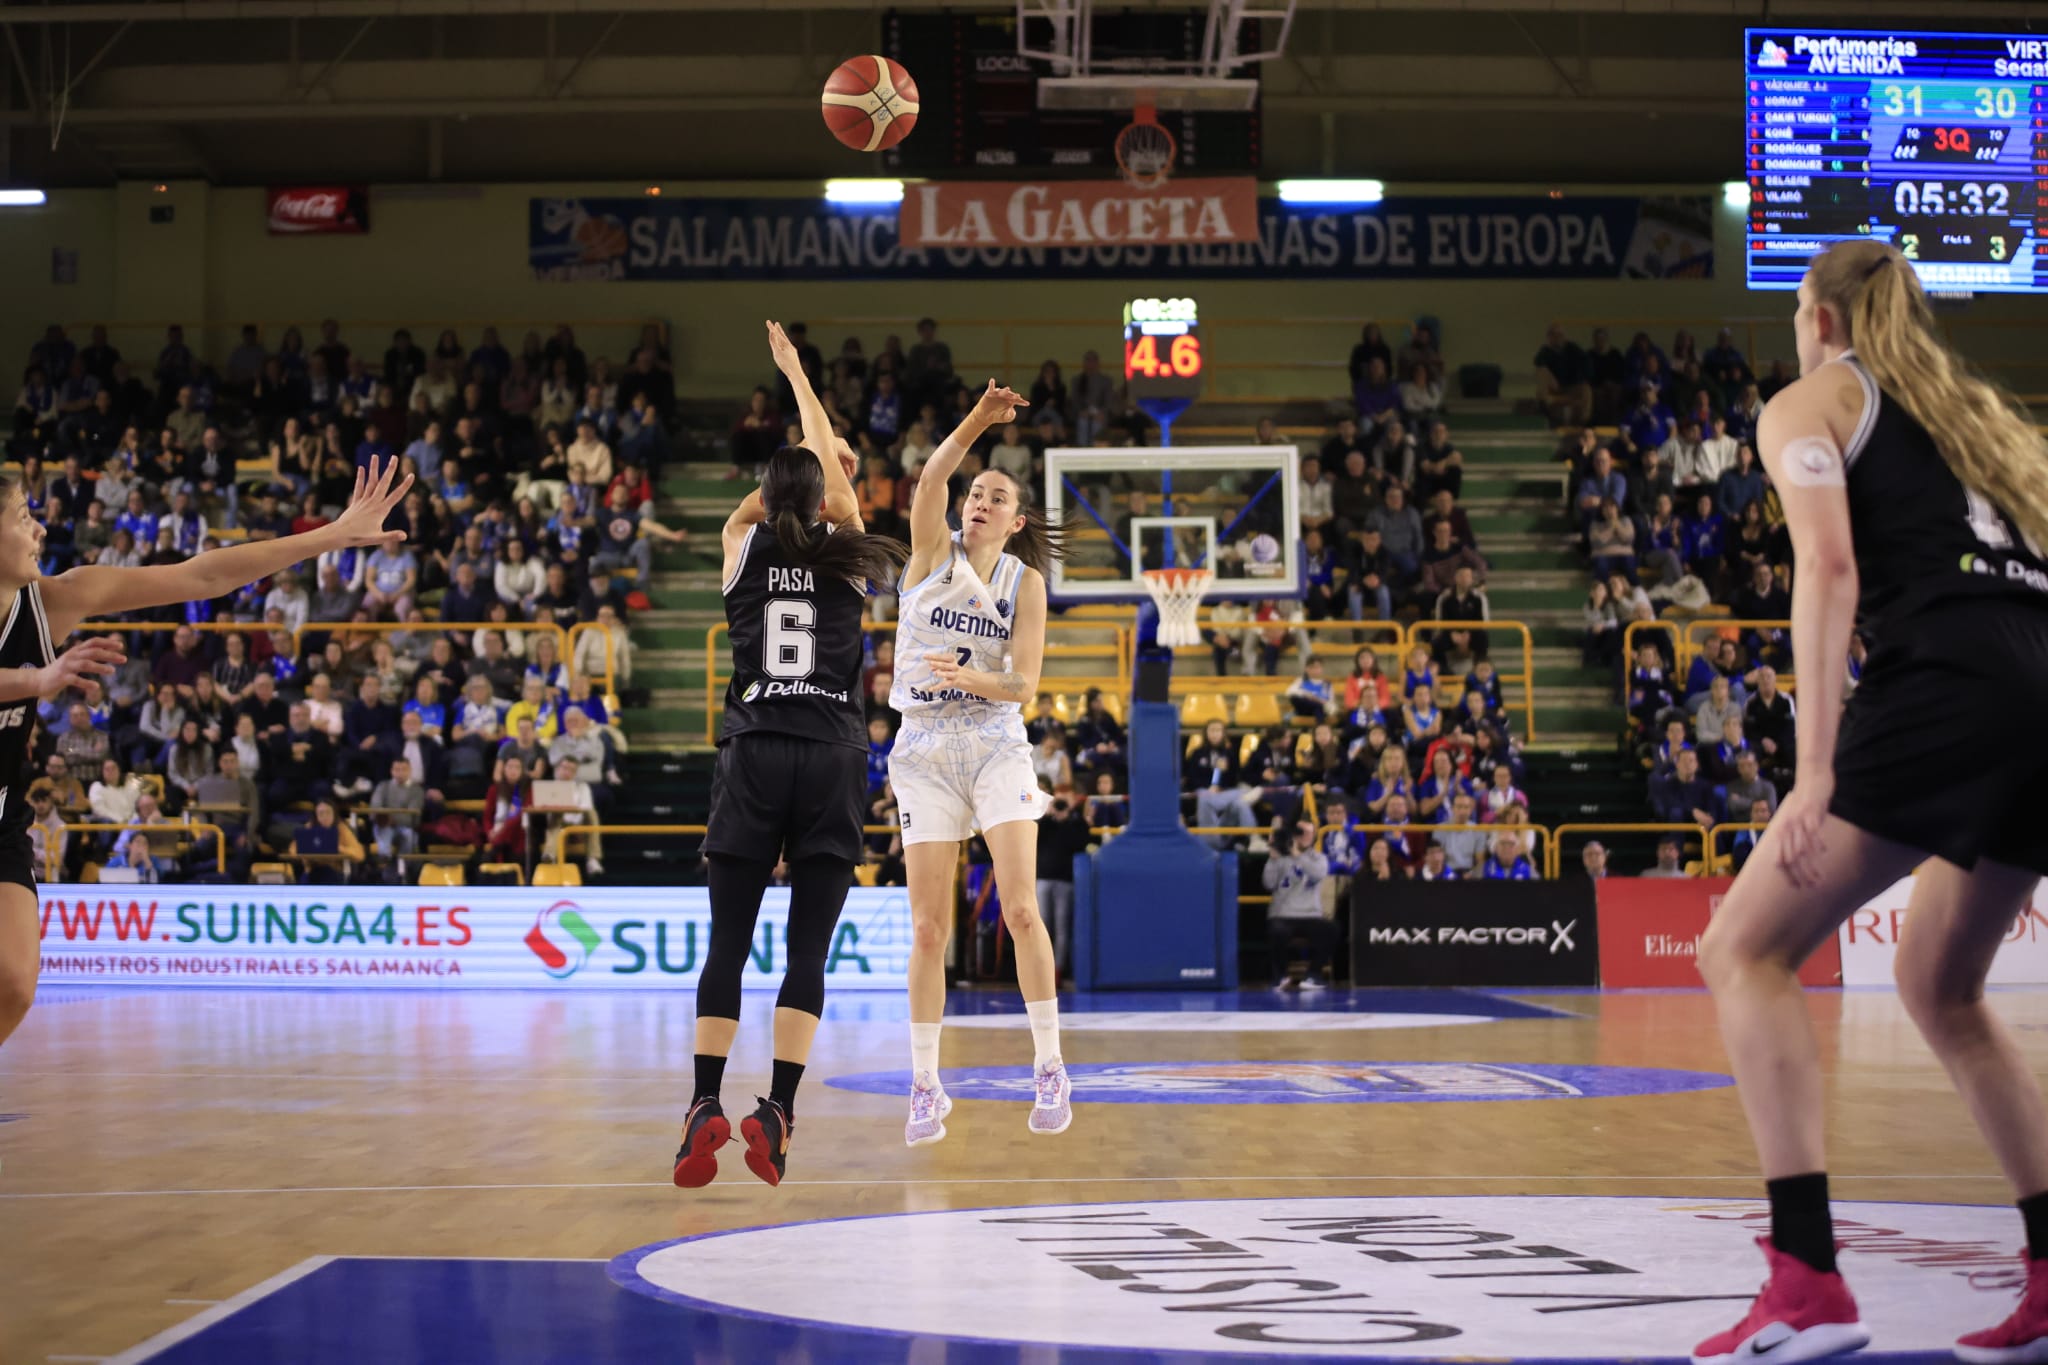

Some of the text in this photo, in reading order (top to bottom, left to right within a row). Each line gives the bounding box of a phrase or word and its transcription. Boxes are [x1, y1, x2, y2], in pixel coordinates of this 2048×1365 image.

[1794, 36, 1918, 57] Perfumerías
[975, 56, 1031, 71] LOCAL
[1808, 56, 1904, 75] AVENIDA
[1884, 85, 1923, 117] 31
[1974, 87, 2017, 119] 30
[1933, 127, 1971, 152] 3Q
[1895, 181, 2009, 217] 05:32
[1353, 214, 1414, 266] DE
[1428, 214, 1615, 267] EUROPA
[1902, 234, 1920, 260] 2
[1990, 236, 2007, 261] 3
[1130, 335, 1202, 378] 4.6
[768, 567, 815, 593] PASA
[762, 598, 816, 679] 6
[1369, 926, 1432, 945] MAX
[1437, 926, 1548, 945] FACTOR
[167, 957, 319, 976] INDUSTRIALES
[325, 958, 463, 977] SALAMANCA
